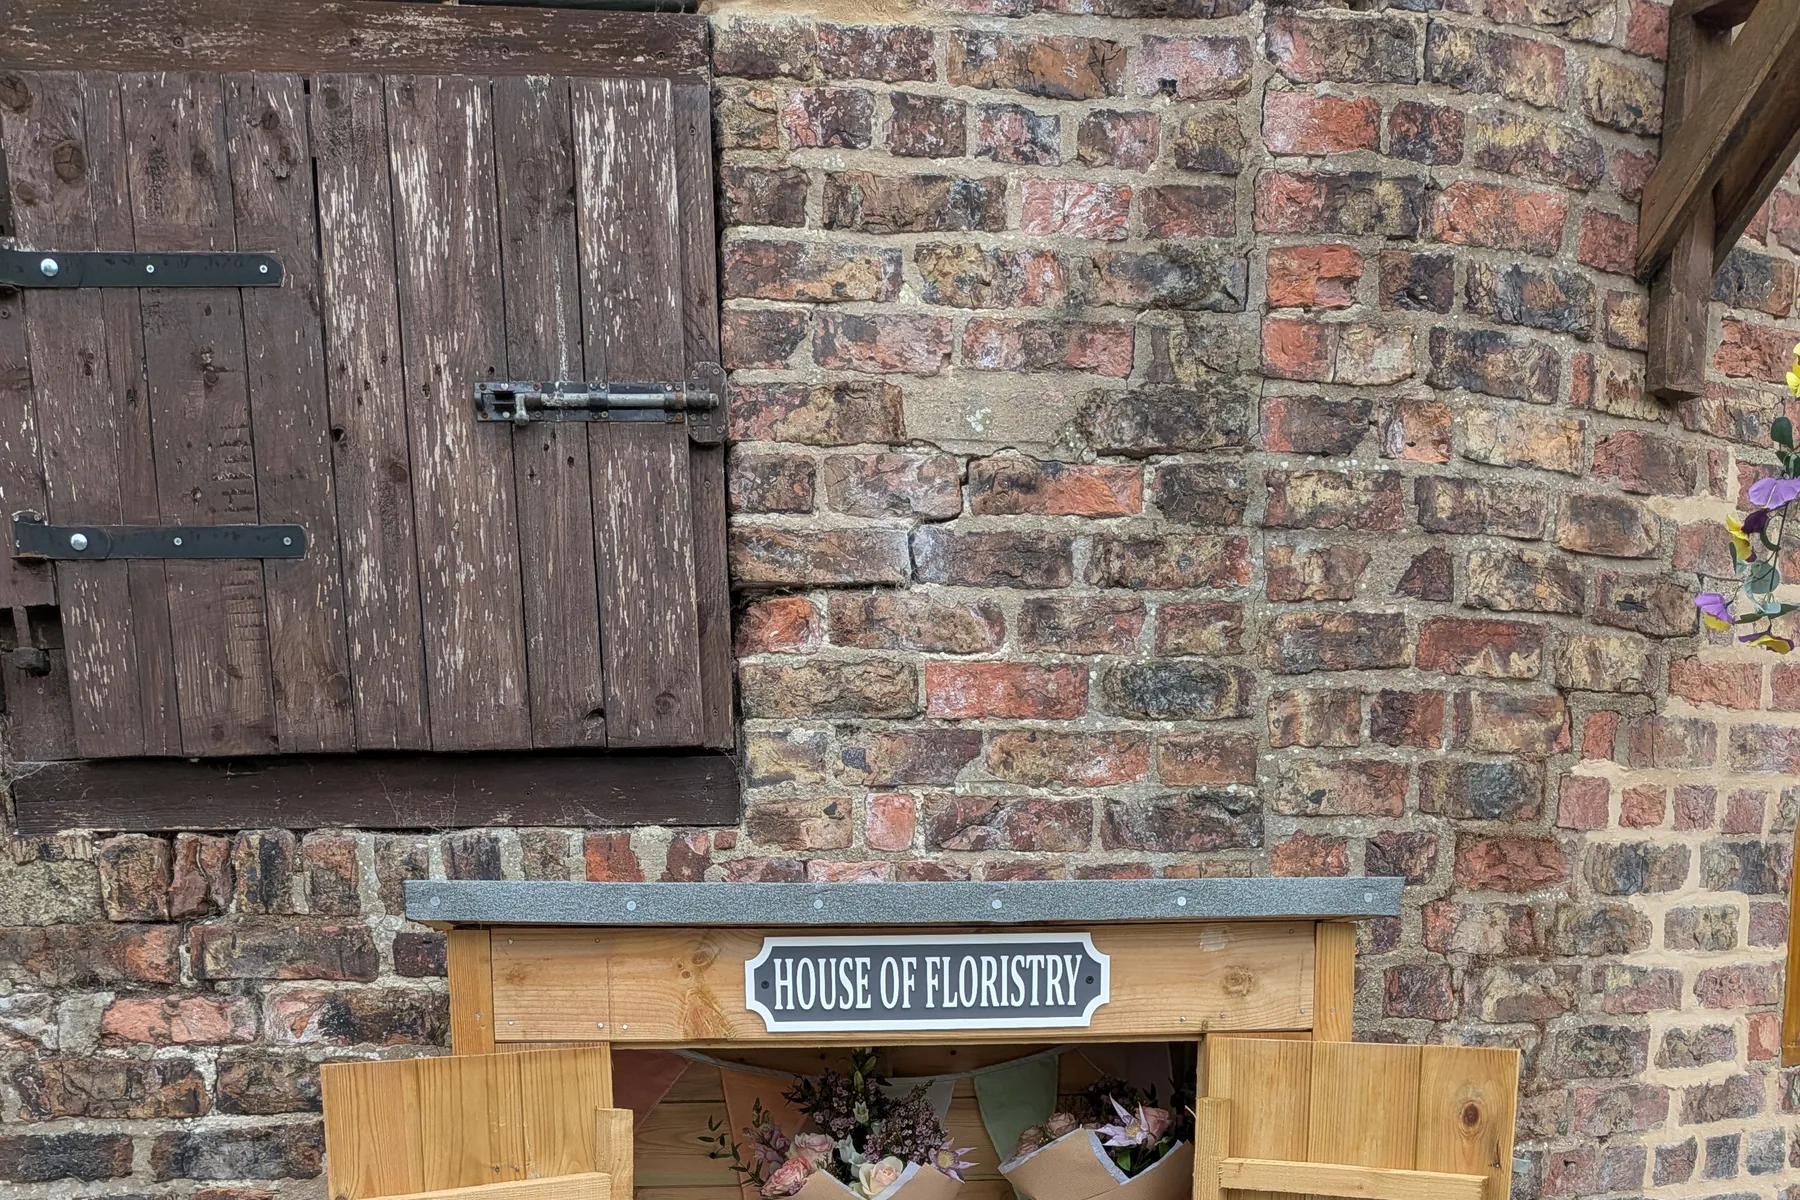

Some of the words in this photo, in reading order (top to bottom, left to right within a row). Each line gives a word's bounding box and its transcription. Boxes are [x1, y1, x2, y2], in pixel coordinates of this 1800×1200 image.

[773, 957, 871, 1010] HOUSE
[879, 956, 917, 1009] OF
[925, 954, 1083, 1009] FLORISTRY
